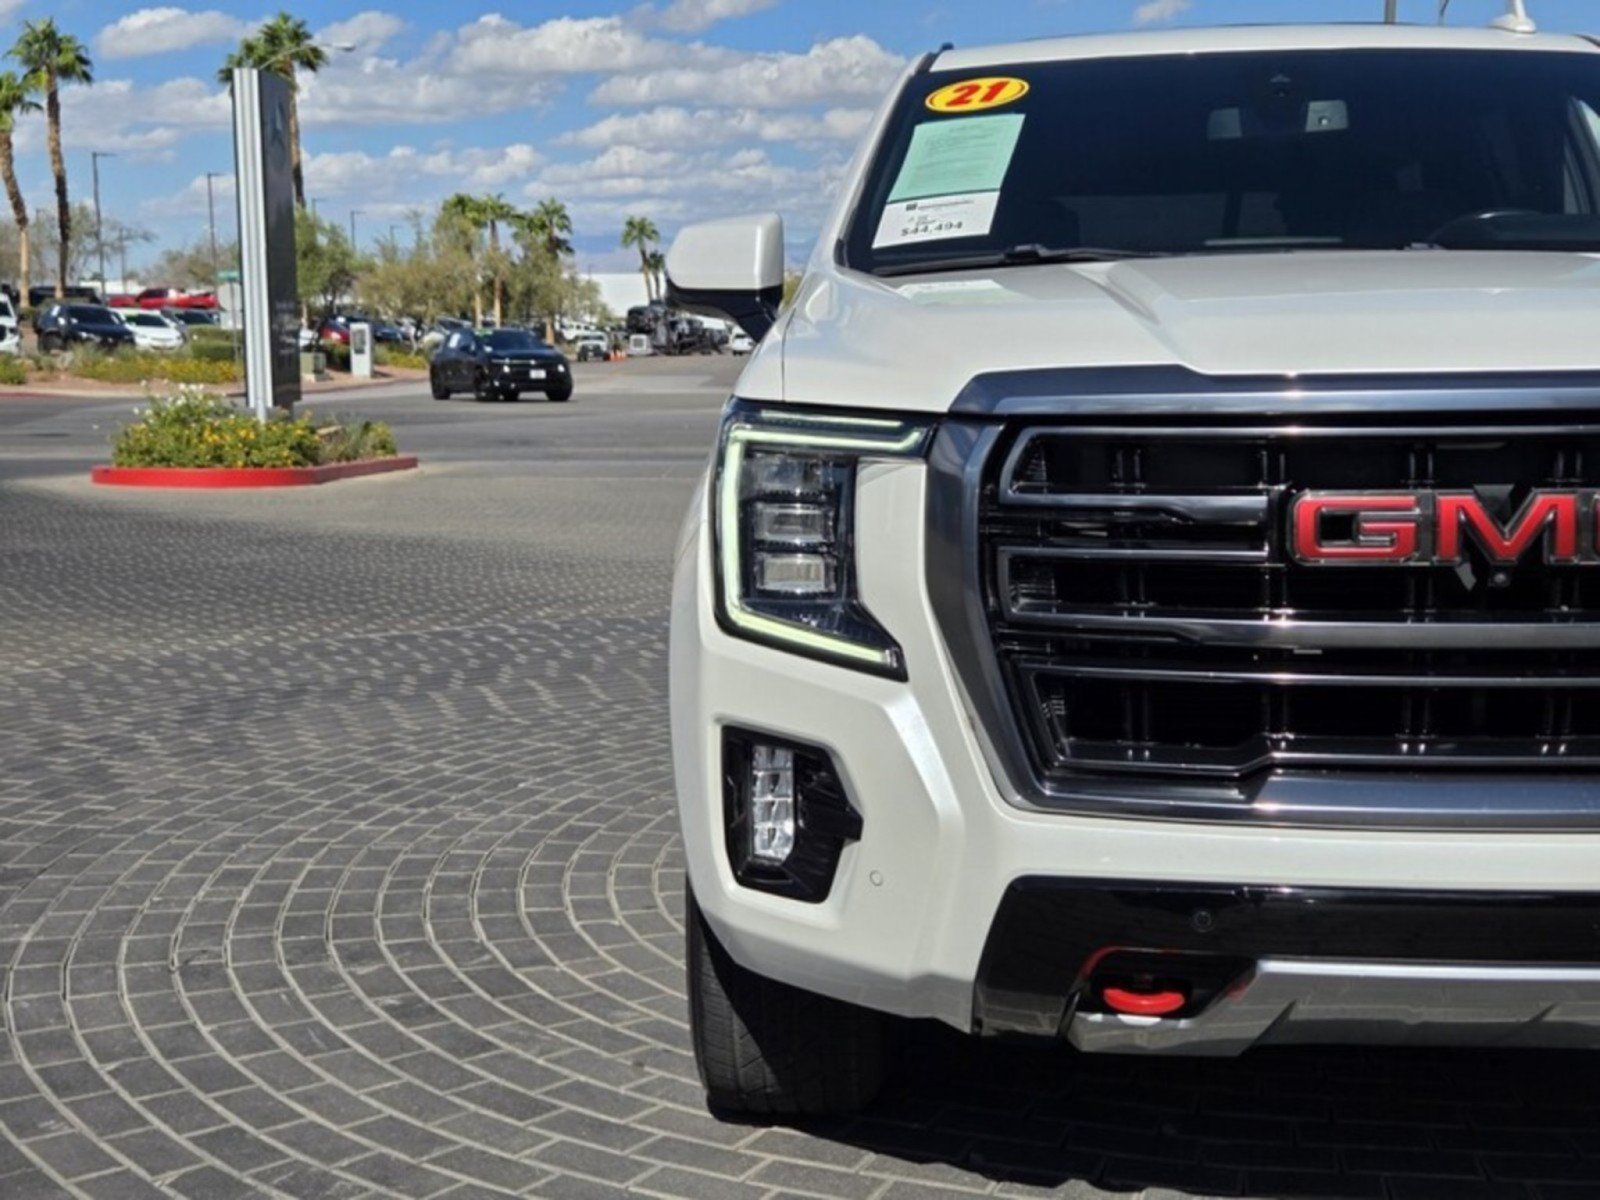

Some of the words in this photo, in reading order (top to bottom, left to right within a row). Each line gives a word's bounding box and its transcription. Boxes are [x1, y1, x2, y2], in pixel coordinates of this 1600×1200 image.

[946, 81, 1010, 107] 21
[902, 222, 962, 236] $44,494
[1290, 489, 1600, 567] GM
